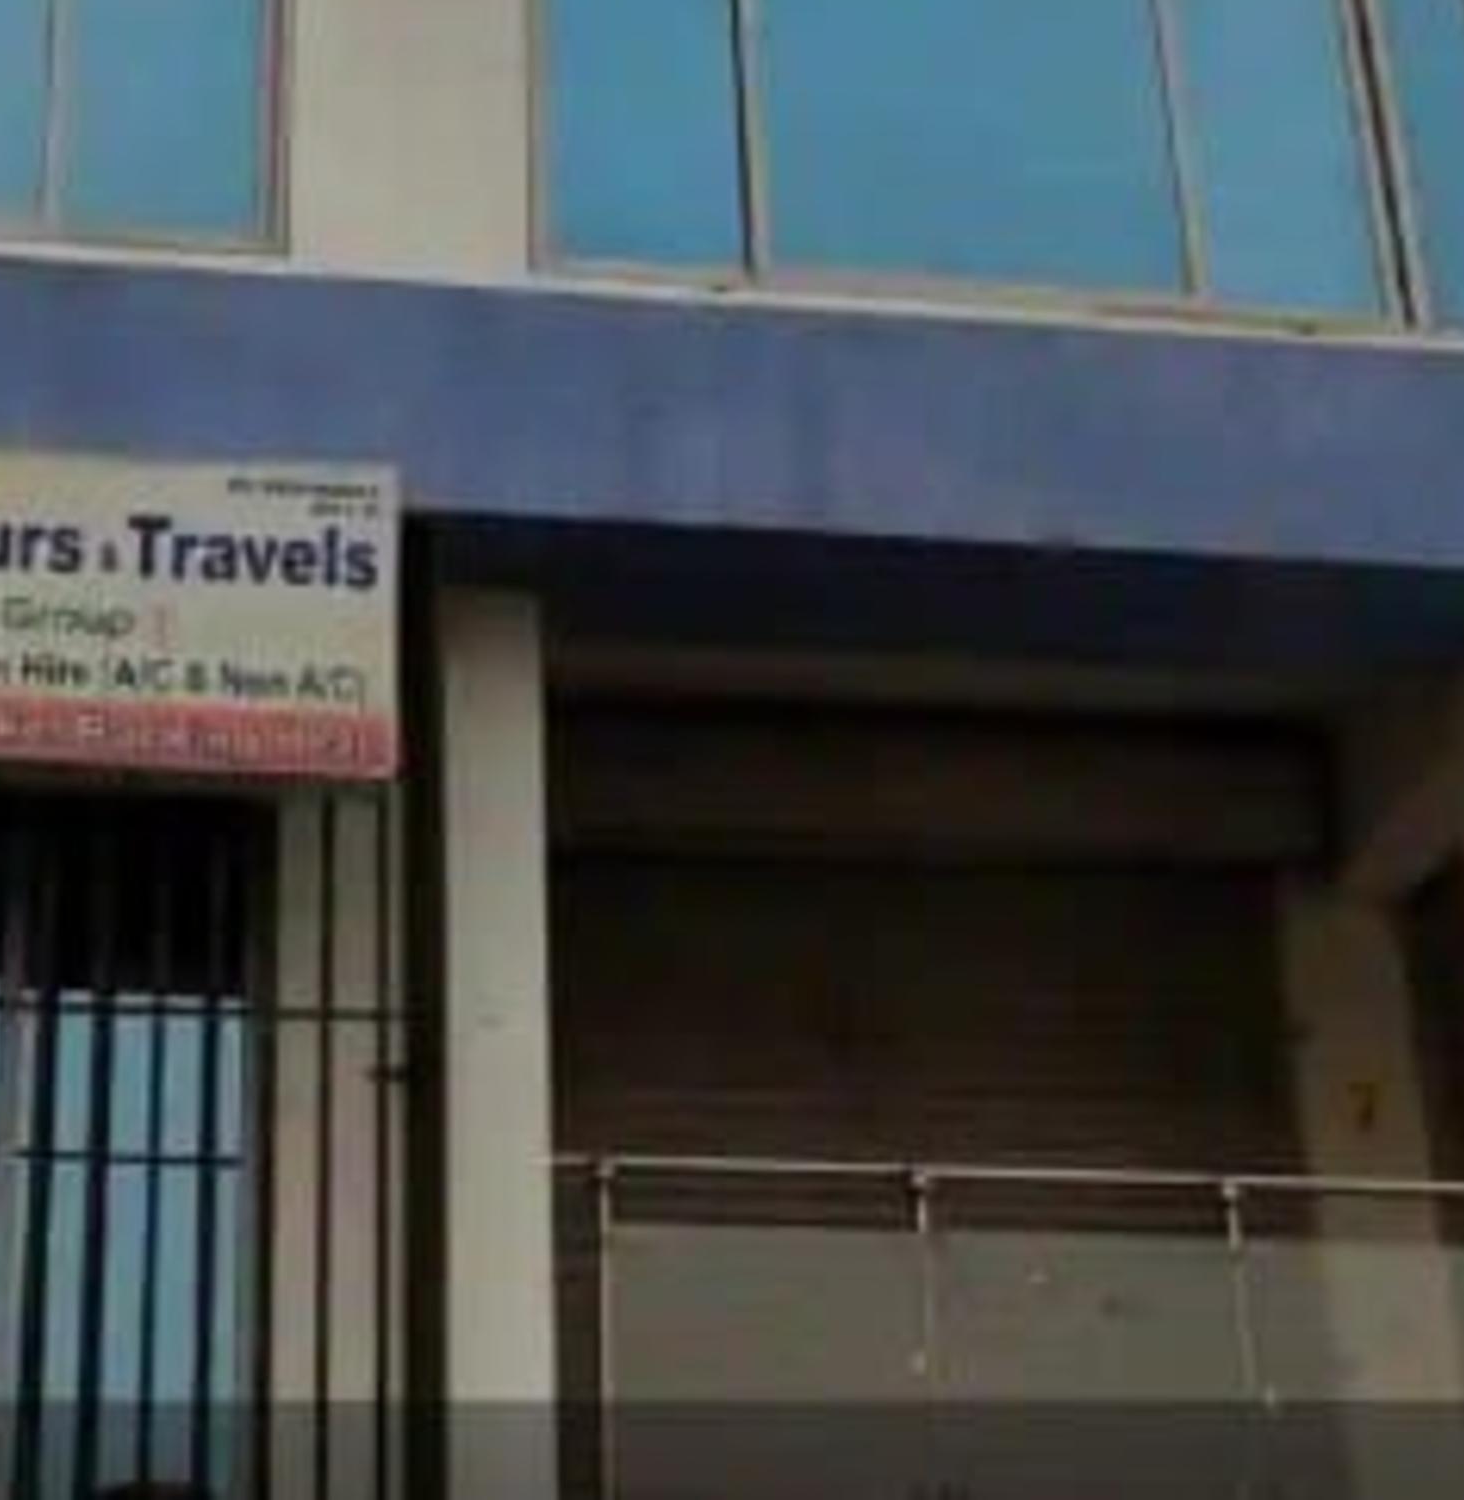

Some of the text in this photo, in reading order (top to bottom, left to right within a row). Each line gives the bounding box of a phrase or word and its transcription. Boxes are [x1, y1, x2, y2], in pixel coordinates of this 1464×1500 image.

[127, 514, 381, 591] Travels
[3, 594, 136, 639] Group
[21, 652, 89, 686] Hire
